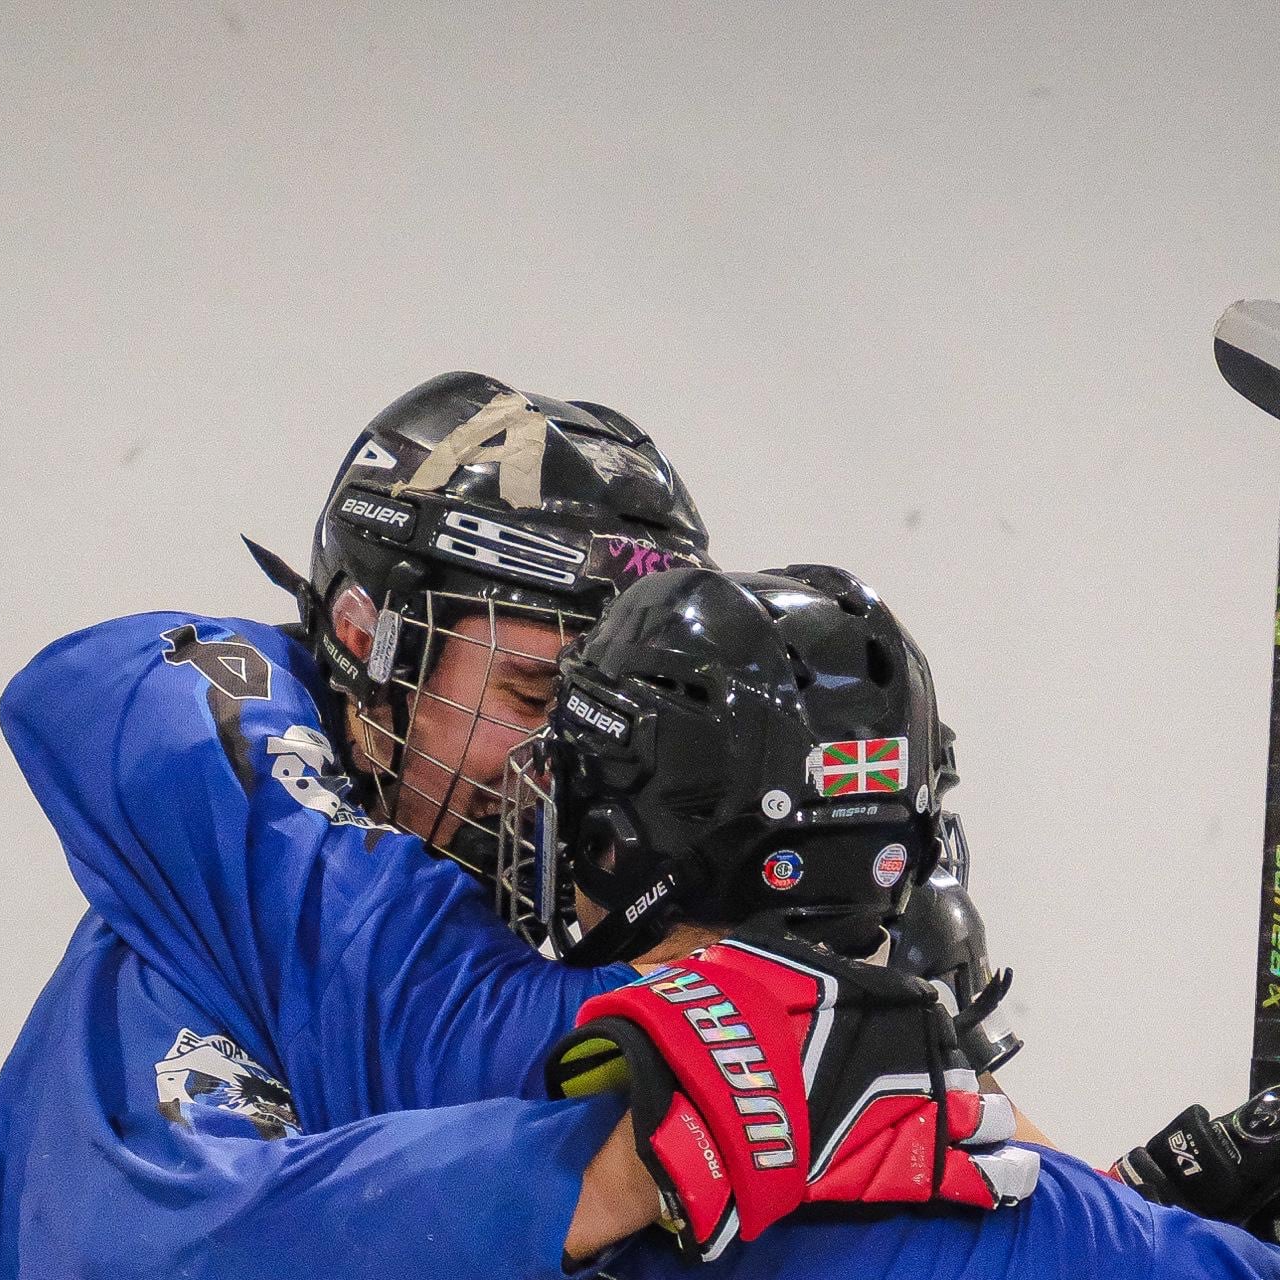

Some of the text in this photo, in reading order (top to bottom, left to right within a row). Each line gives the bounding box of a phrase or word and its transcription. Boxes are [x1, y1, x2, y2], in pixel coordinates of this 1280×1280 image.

[340, 498, 410, 528] BAUER
[566, 694, 626, 739] BAUER
[681, 1113, 723, 1180] PROCUFF
